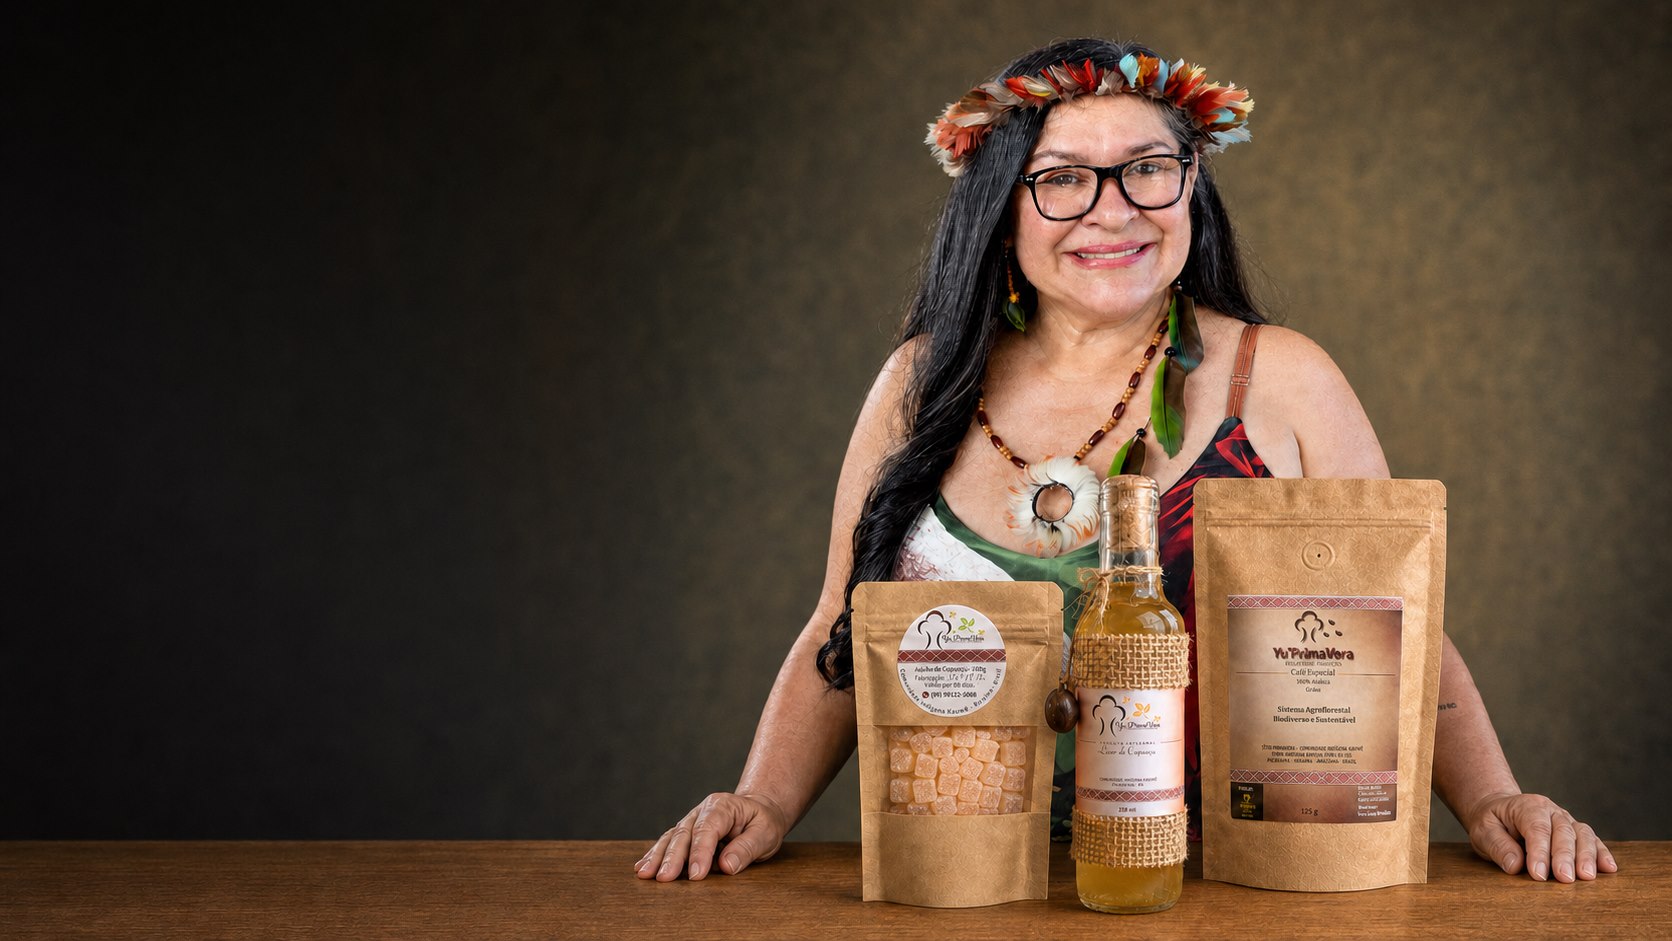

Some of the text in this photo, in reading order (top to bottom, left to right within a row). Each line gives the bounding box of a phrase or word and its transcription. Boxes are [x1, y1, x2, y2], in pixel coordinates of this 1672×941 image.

[1290, 668, 1306, 677] Café
[1277, 705, 1351, 715] Sistema Agroflorestal
[1273, 715, 1309, 723] Biodiverso
[1315, 716, 1356, 724] Sustentável
[1313, 808, 1319, 816] g
